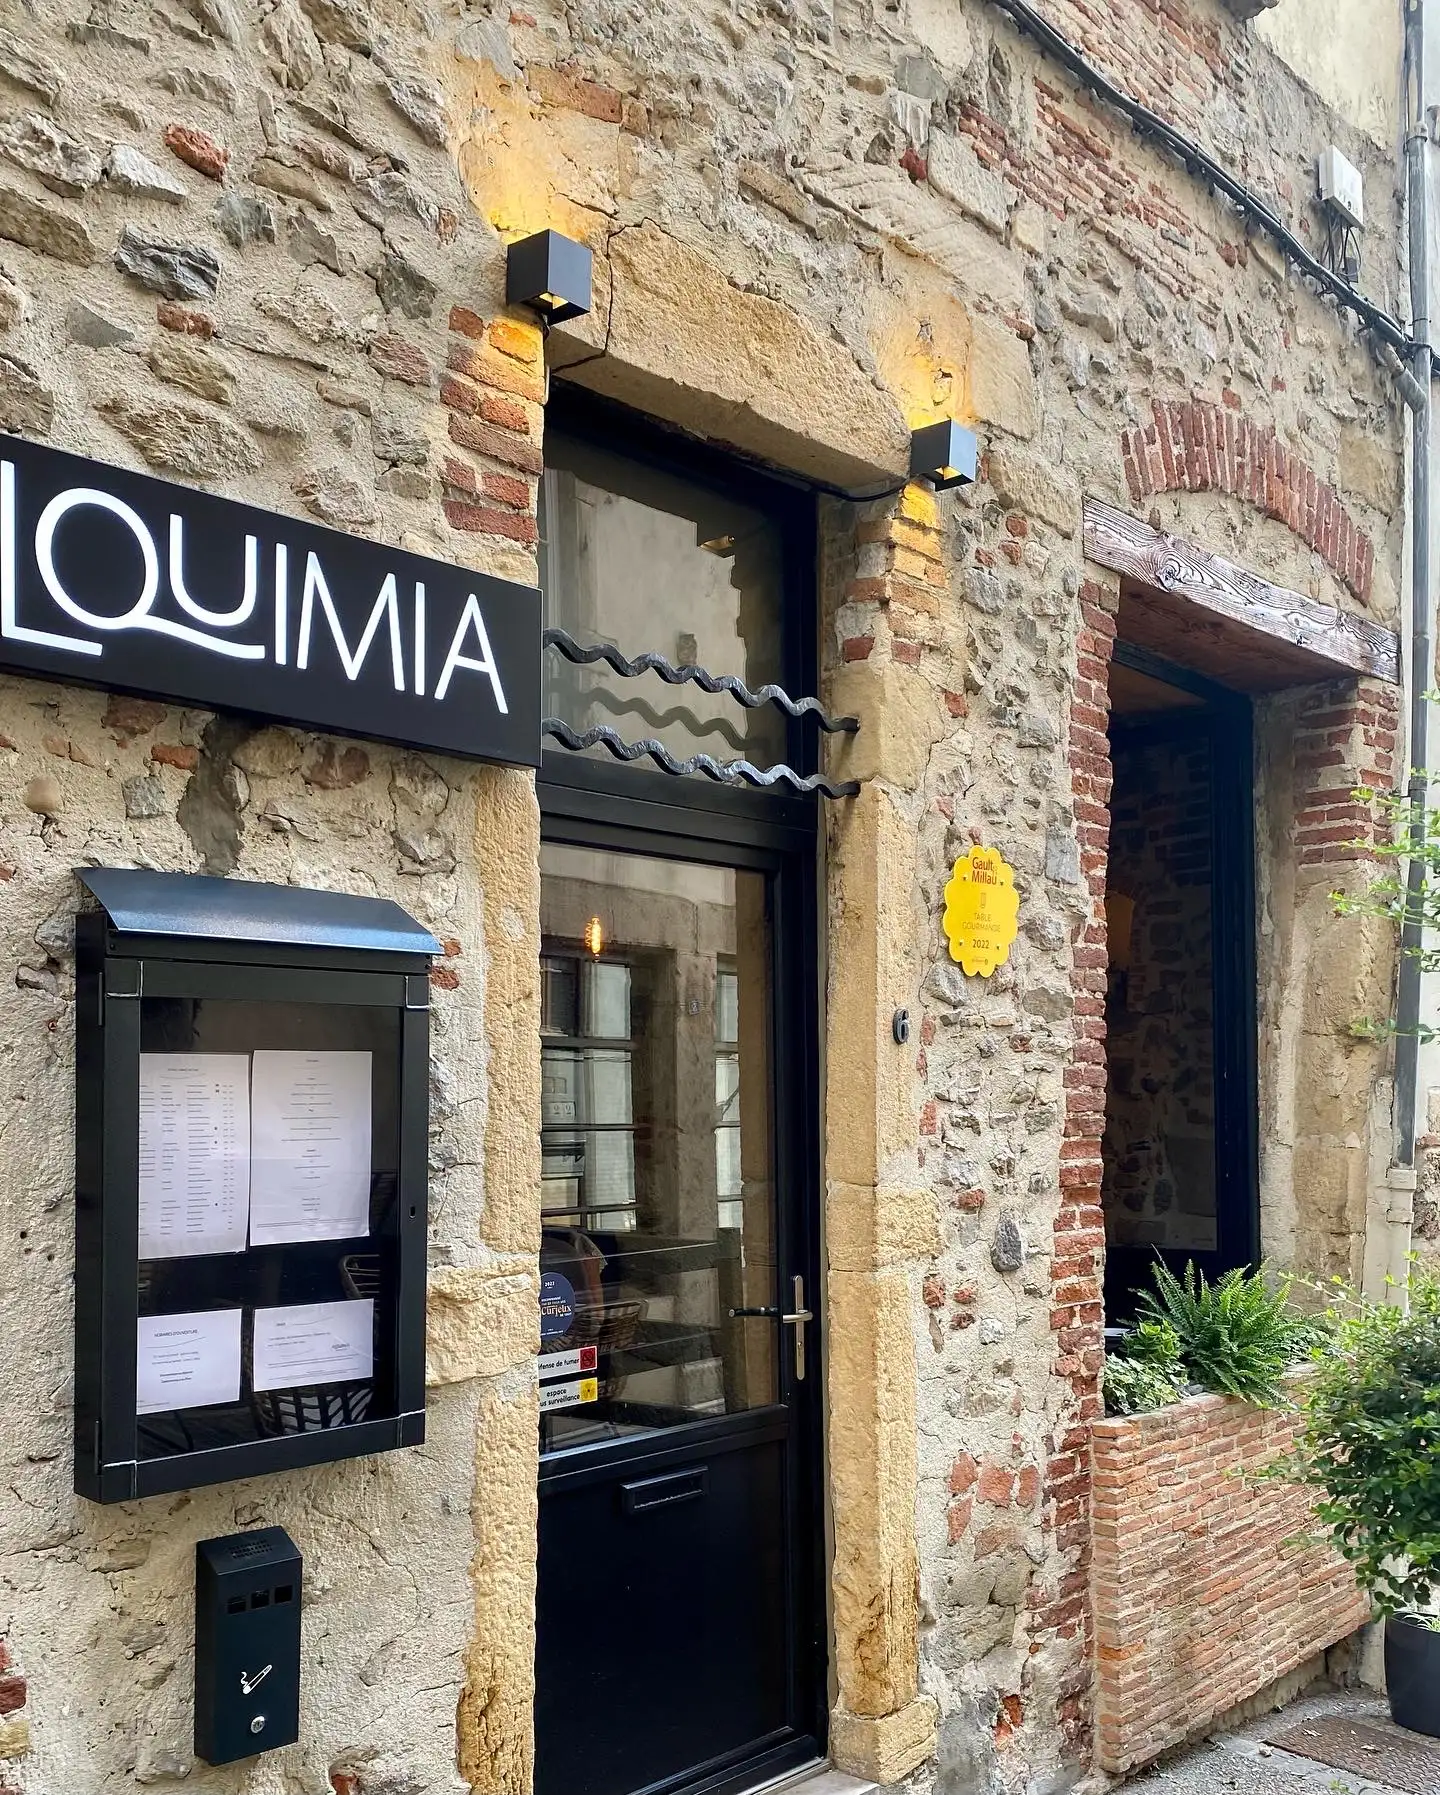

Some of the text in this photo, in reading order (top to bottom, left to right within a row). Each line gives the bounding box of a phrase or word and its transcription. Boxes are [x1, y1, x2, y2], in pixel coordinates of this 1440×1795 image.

[972, 856, 994, 871] Gault
[971, 870, 997, 885] Millau
[973, 912, 992, 922] TABLE
[972, 938, 990, 949] 2022
[546, 1388, 567, 1397] espace
[548, 1394, 580, 1406] surveillance
